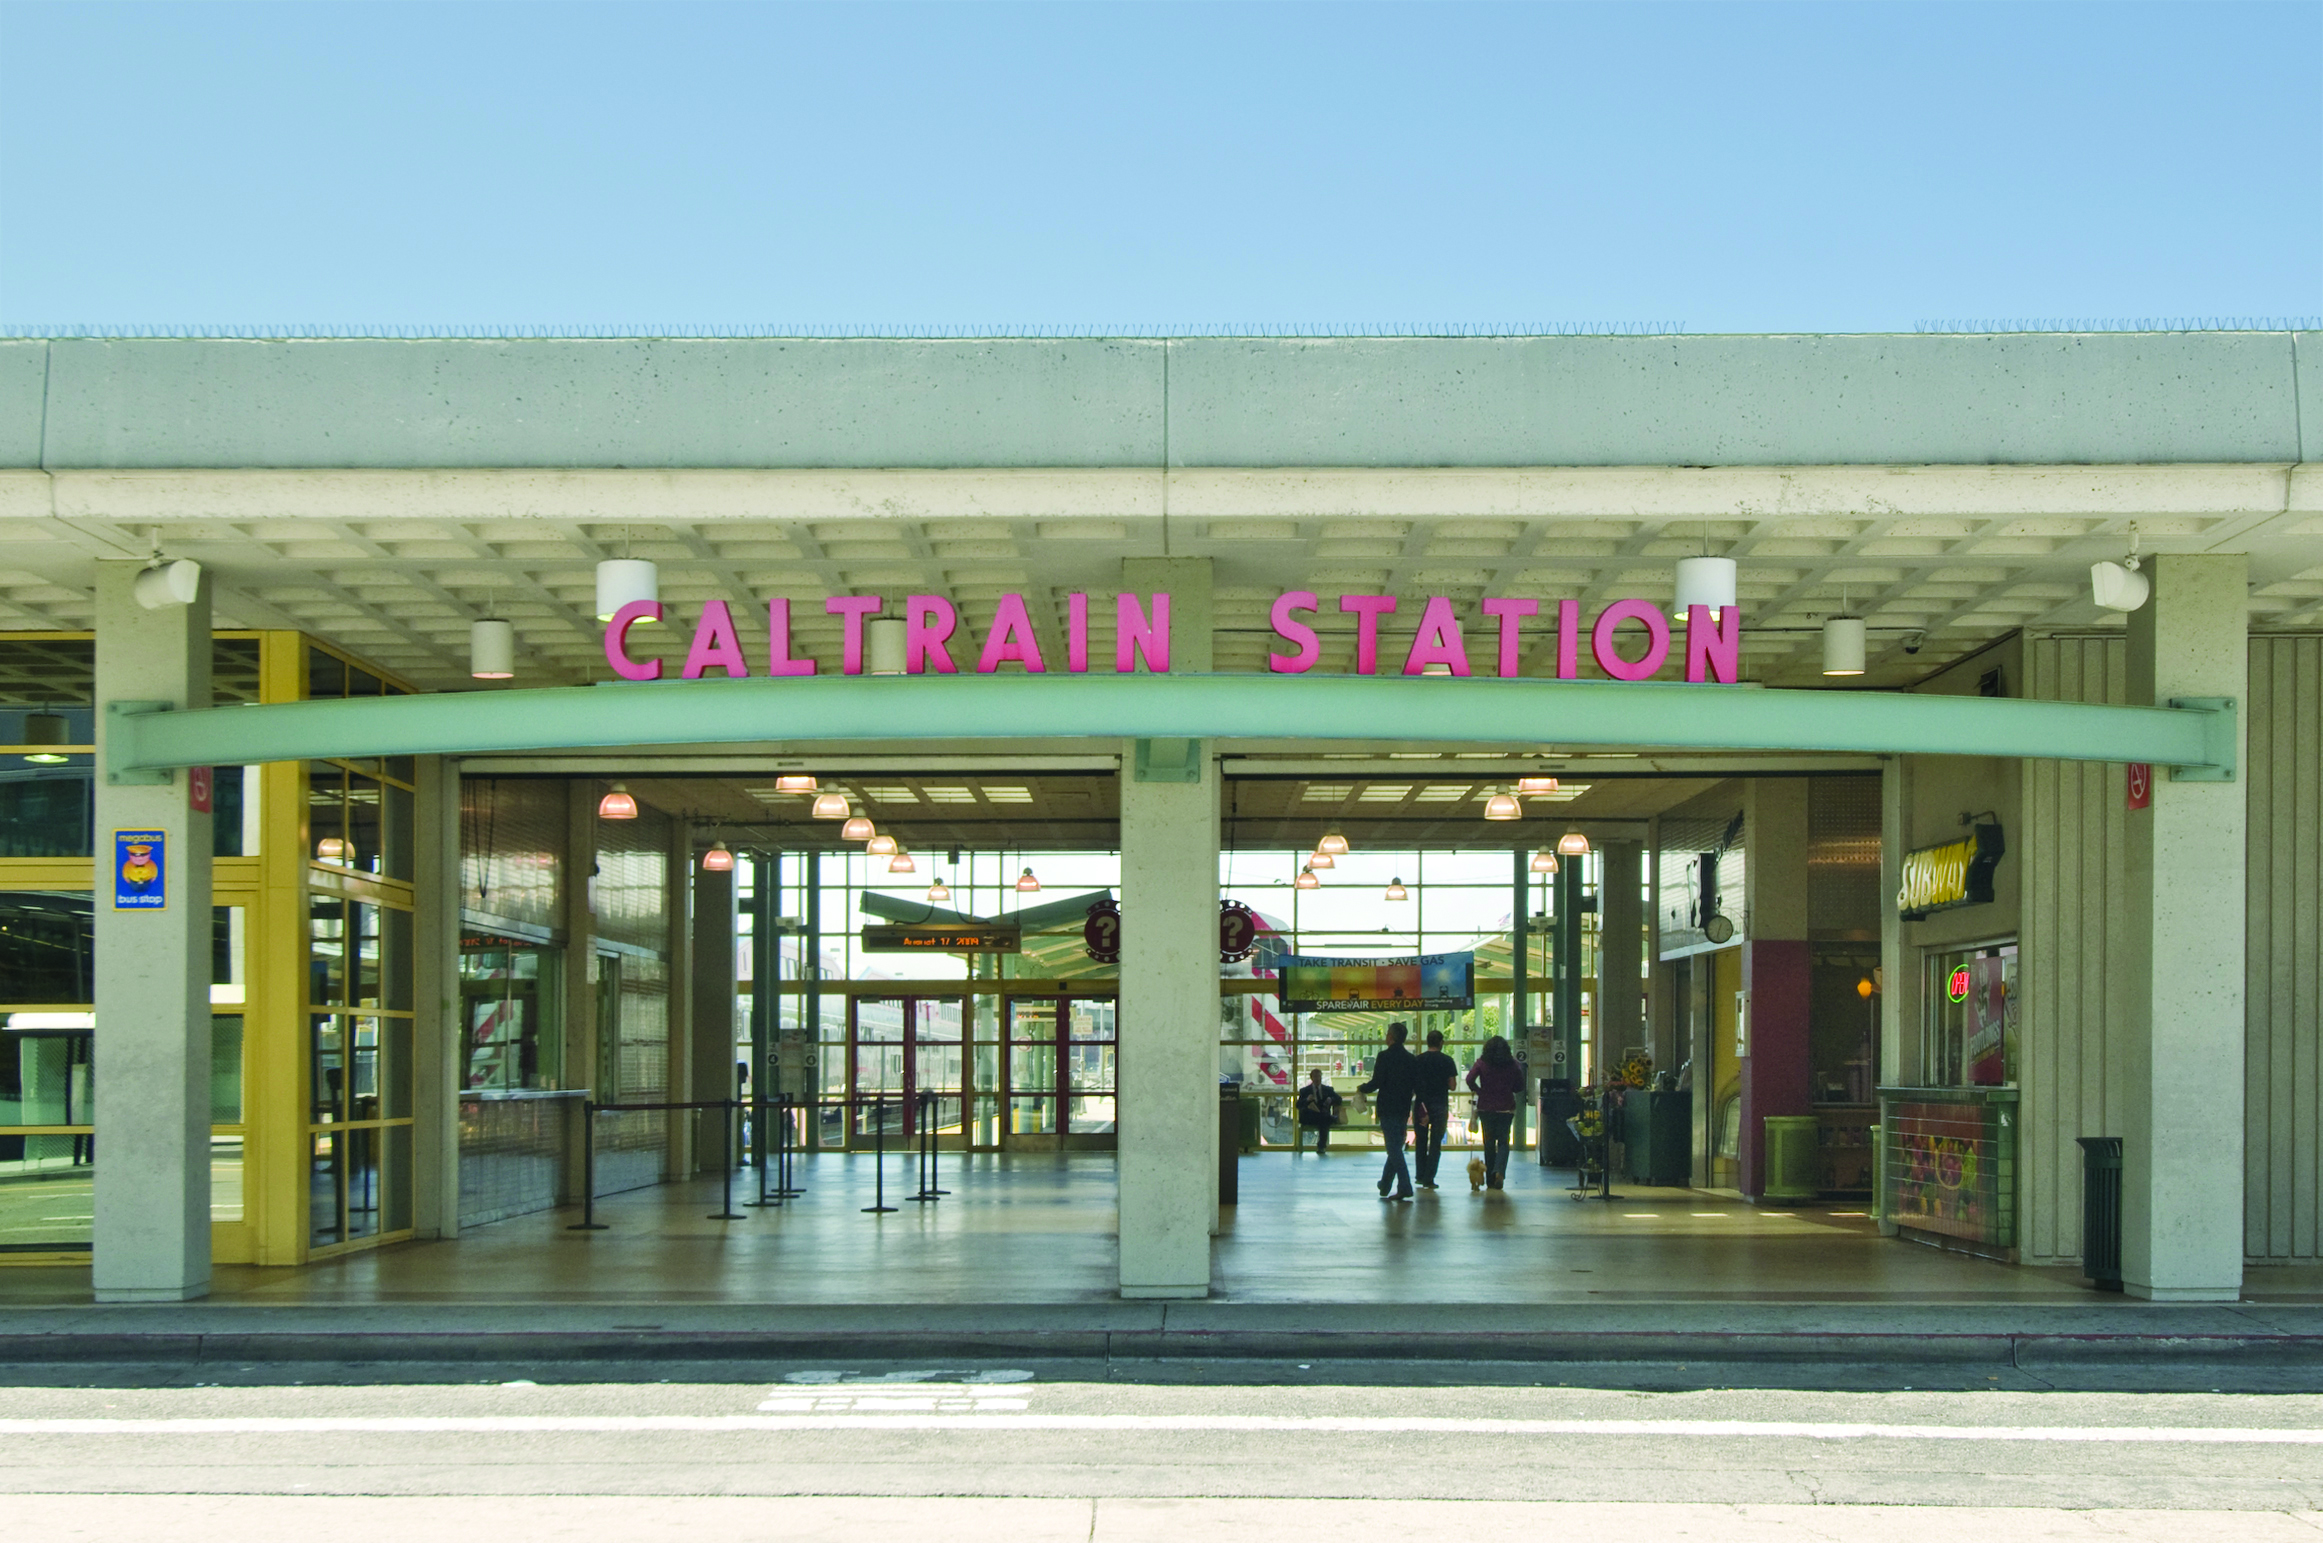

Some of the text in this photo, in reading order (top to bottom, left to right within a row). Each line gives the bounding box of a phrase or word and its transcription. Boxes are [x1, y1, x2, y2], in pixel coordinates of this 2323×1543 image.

[604, 591, 1740, 684] CALTRAIN STATION
[1897, 834, 1977, 910] SUBWAY
[117, 895, 163, 905] bus stop
[940, 938, 950, 946] 17
[1299, 956, 1444, 967] TAKE TRANSIT SAVE GAS
[1951, 971, 1970, 996] OPEN
[1316, 1000, 1347, 1010] SPARE
[1371, 1000, 1401, 1009] EVERY
[1404, 999, 1424, 1008] DAY
